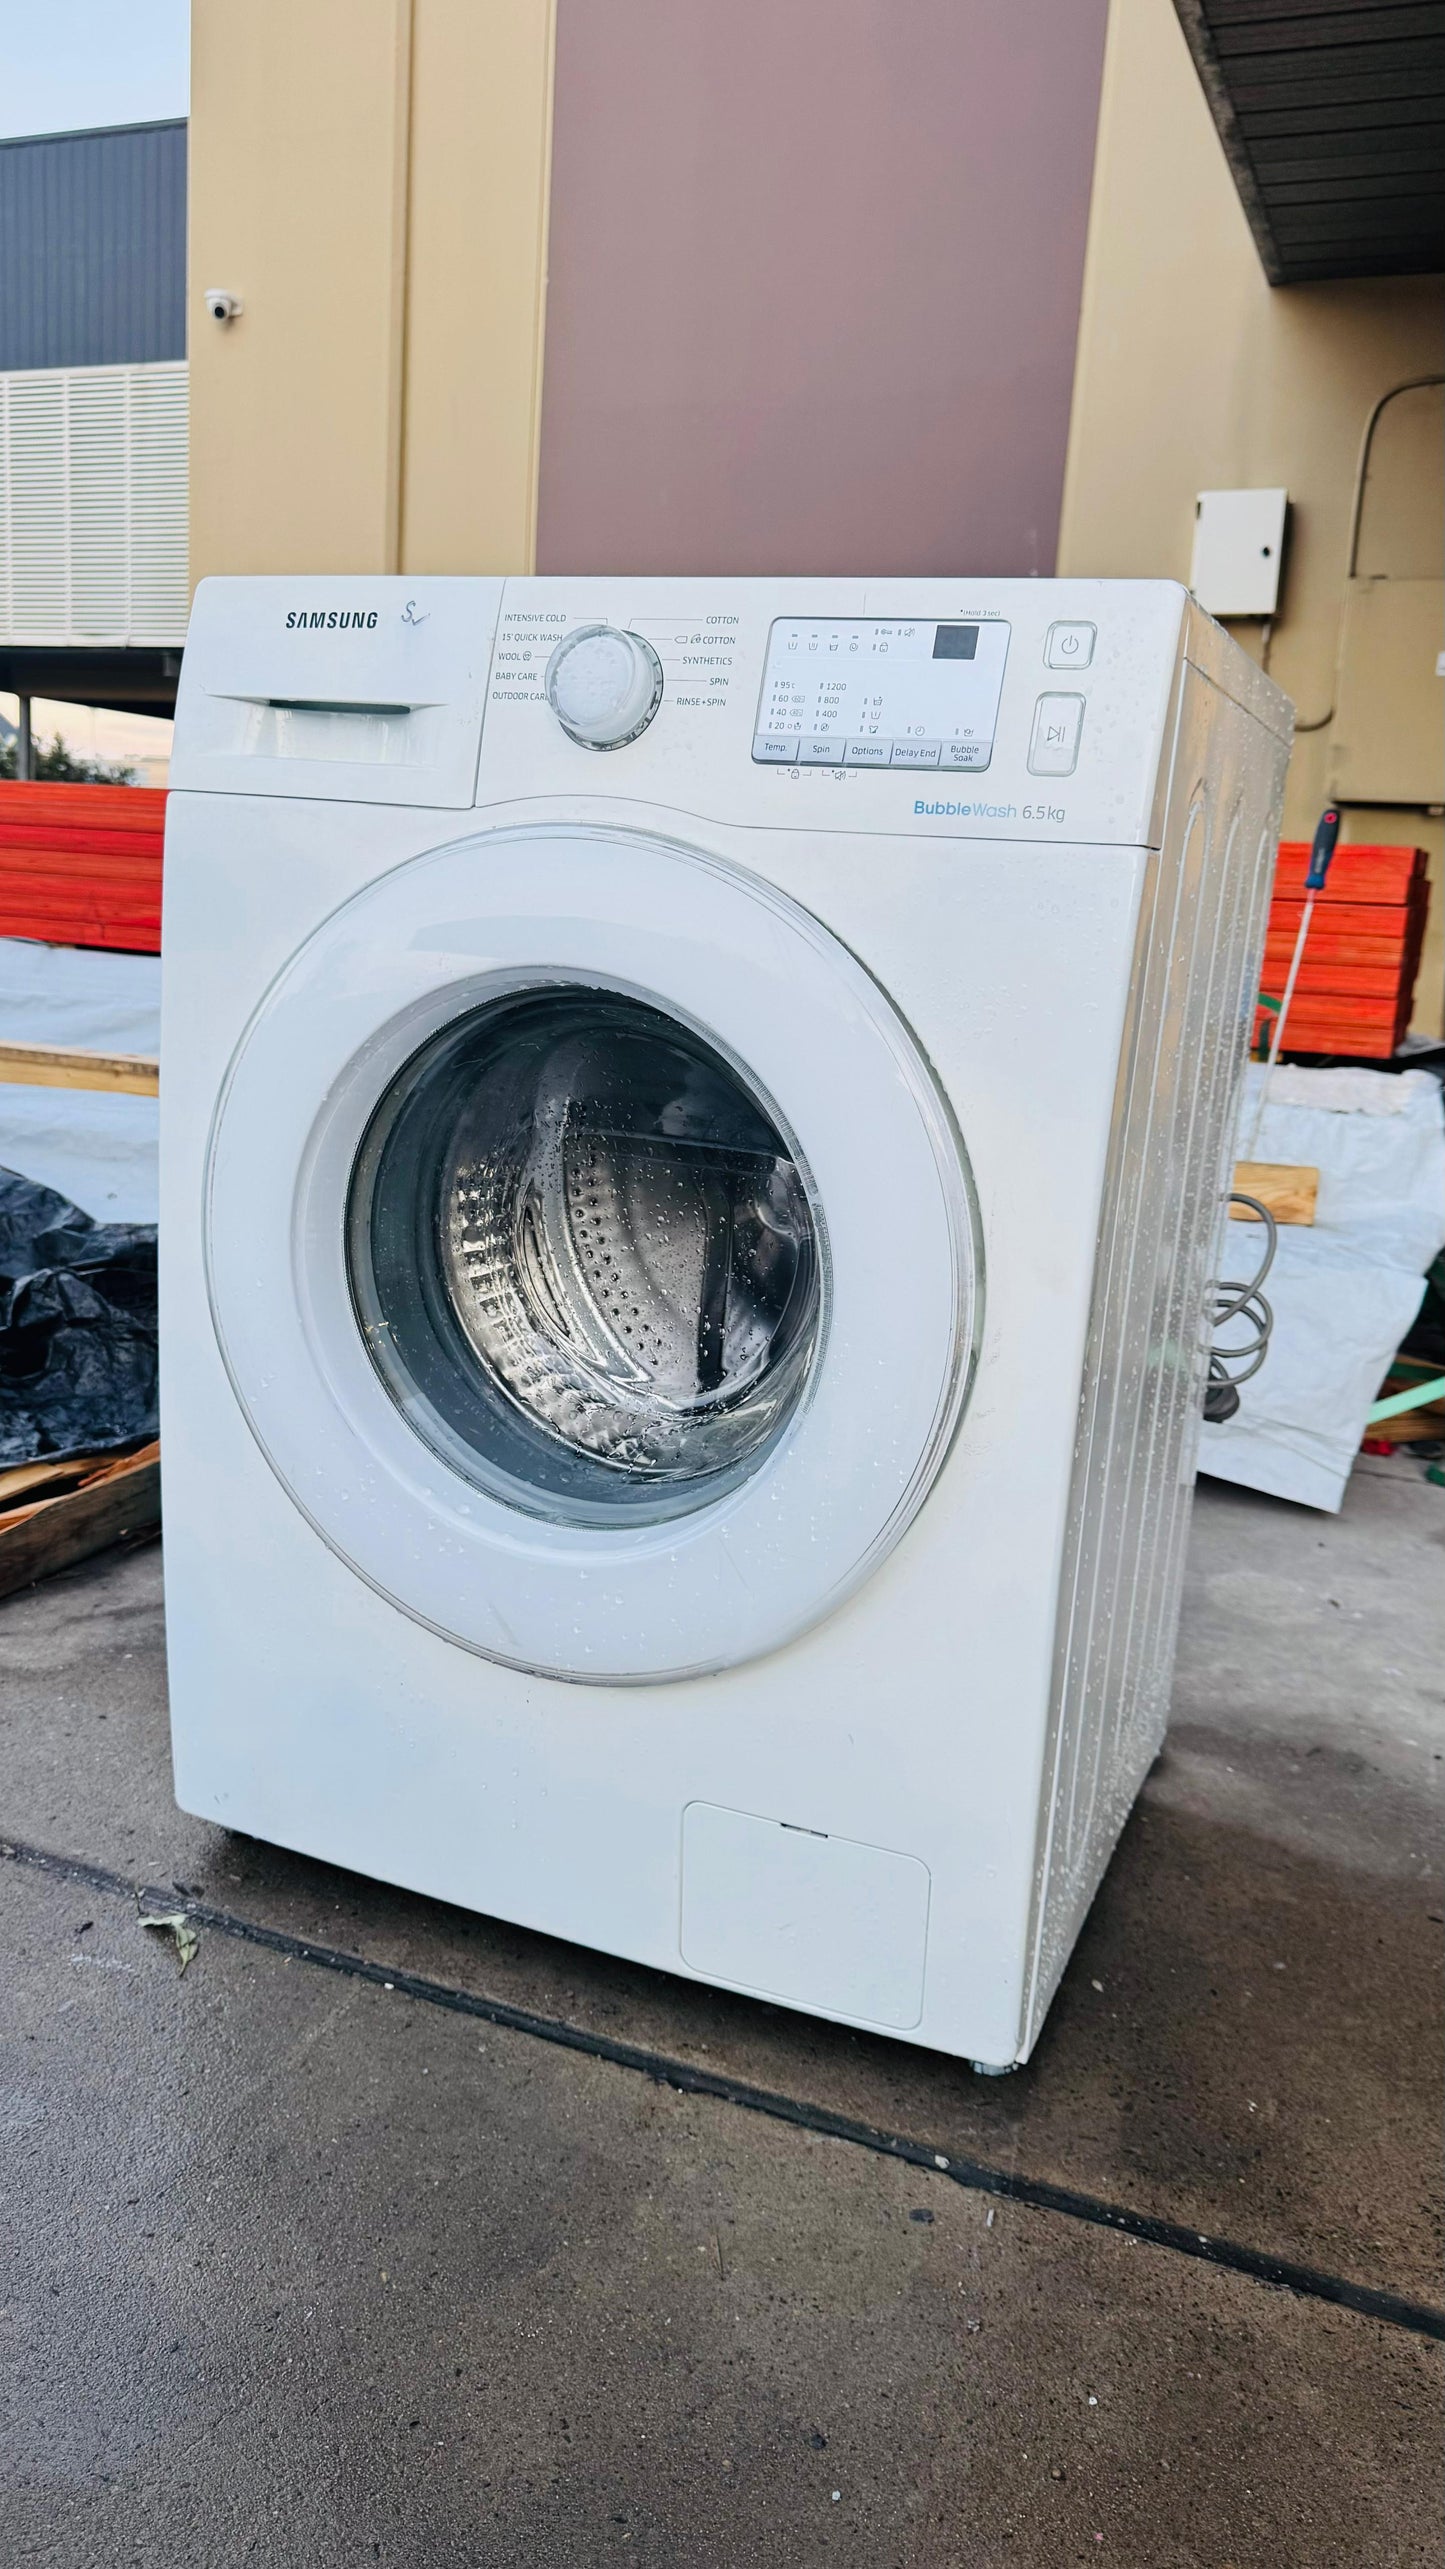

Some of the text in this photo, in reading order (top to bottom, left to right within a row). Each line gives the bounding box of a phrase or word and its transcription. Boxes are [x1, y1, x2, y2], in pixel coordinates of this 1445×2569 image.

[286, 612, 378, 629] SAMSUNG
[504, 614, 567, 622] INTENSIVE COLD
[706, 616, 740, 624] COTTON
[514, 633, 538, 642] QUICK
[702, 636, 736, 645] COTTON
[498, 652, 521, 661] WOOL
[682, 656, 733, 665] SYNTHETICS
[495, 672, 538, 681] BABY CARE
[709, 677, 729, 686] SPIN
[826, 682, 847, 691] 1200
[492, 691, 529, 700] OUTDOOR
[778, 694, 789, 703] 60
[823, 696, 840, 705] 800
[776, 708, 787, 716] 40
[822, 710, 838, 718] 400
[774, 721, 785, 730] 20
[765, 743, 788, 752] Temp.
[812, 745, 830, 754] Spin
[851, 746, 884, 756] Options
[951, 745, 980, 754] Bubble
[895, 748, 937, 758] Delay End
[954, 754, 974, 762] Soak
